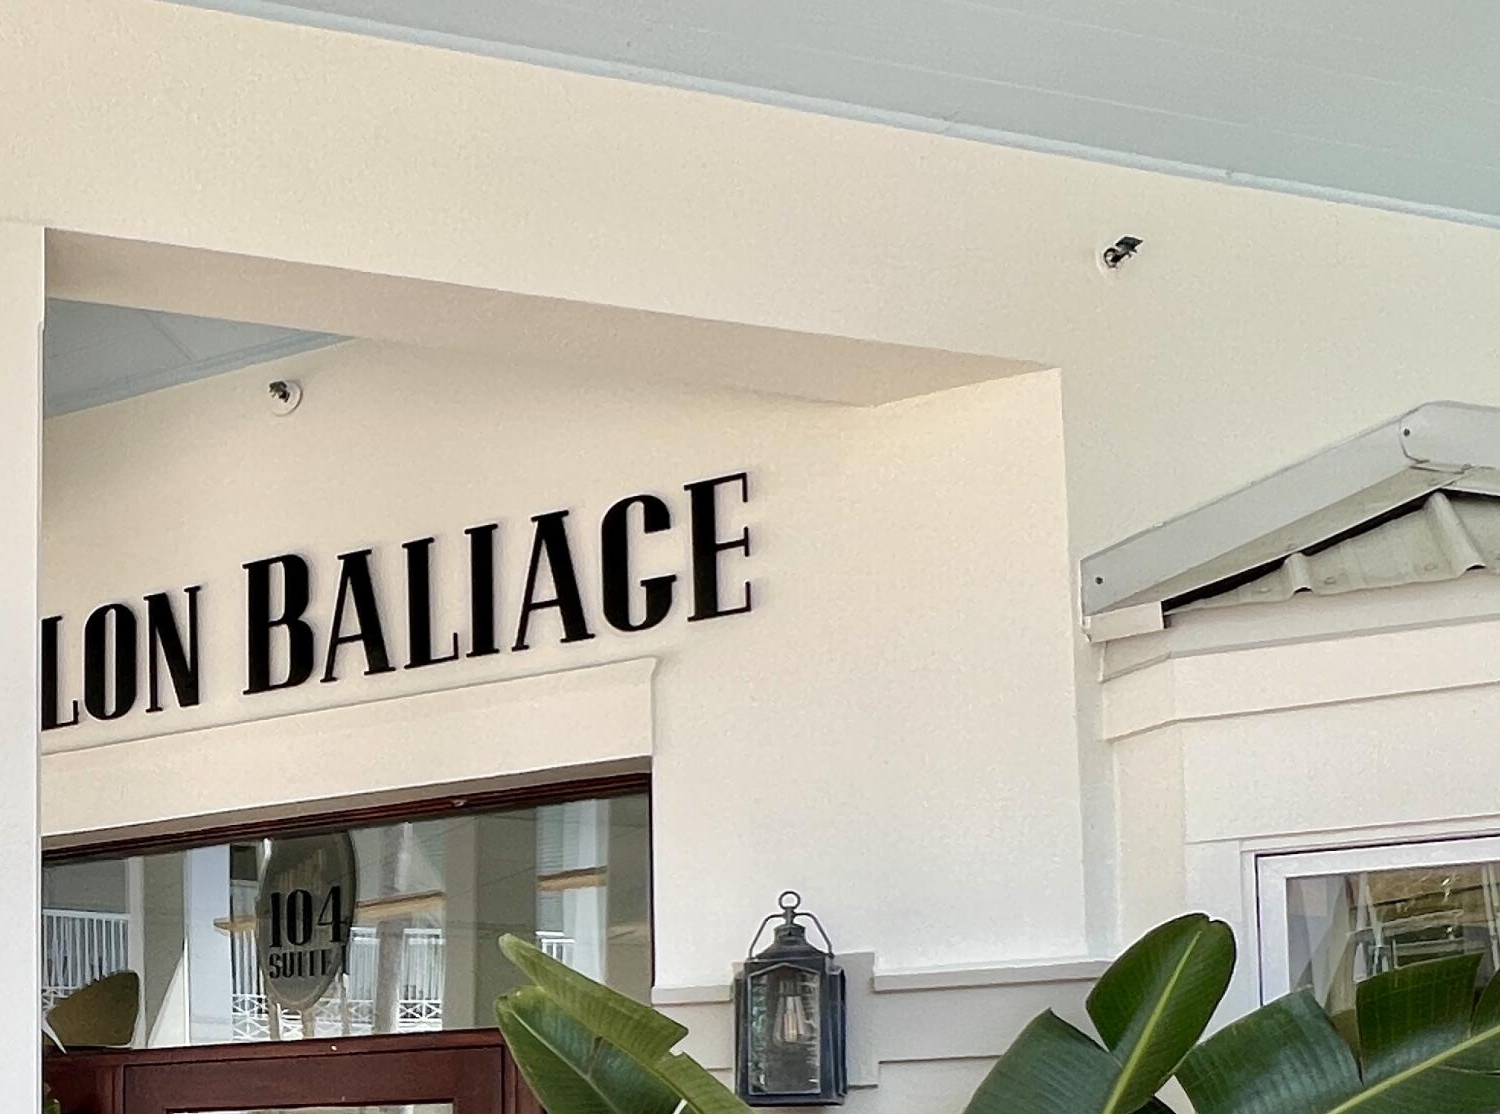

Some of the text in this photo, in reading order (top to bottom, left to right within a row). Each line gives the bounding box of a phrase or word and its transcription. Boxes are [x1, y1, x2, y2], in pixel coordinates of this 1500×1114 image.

[41, 472, 752, 731] LON BALIAGE
[269, 885, 348, 948] 104
[268, 948, 332, 978] SUITE
